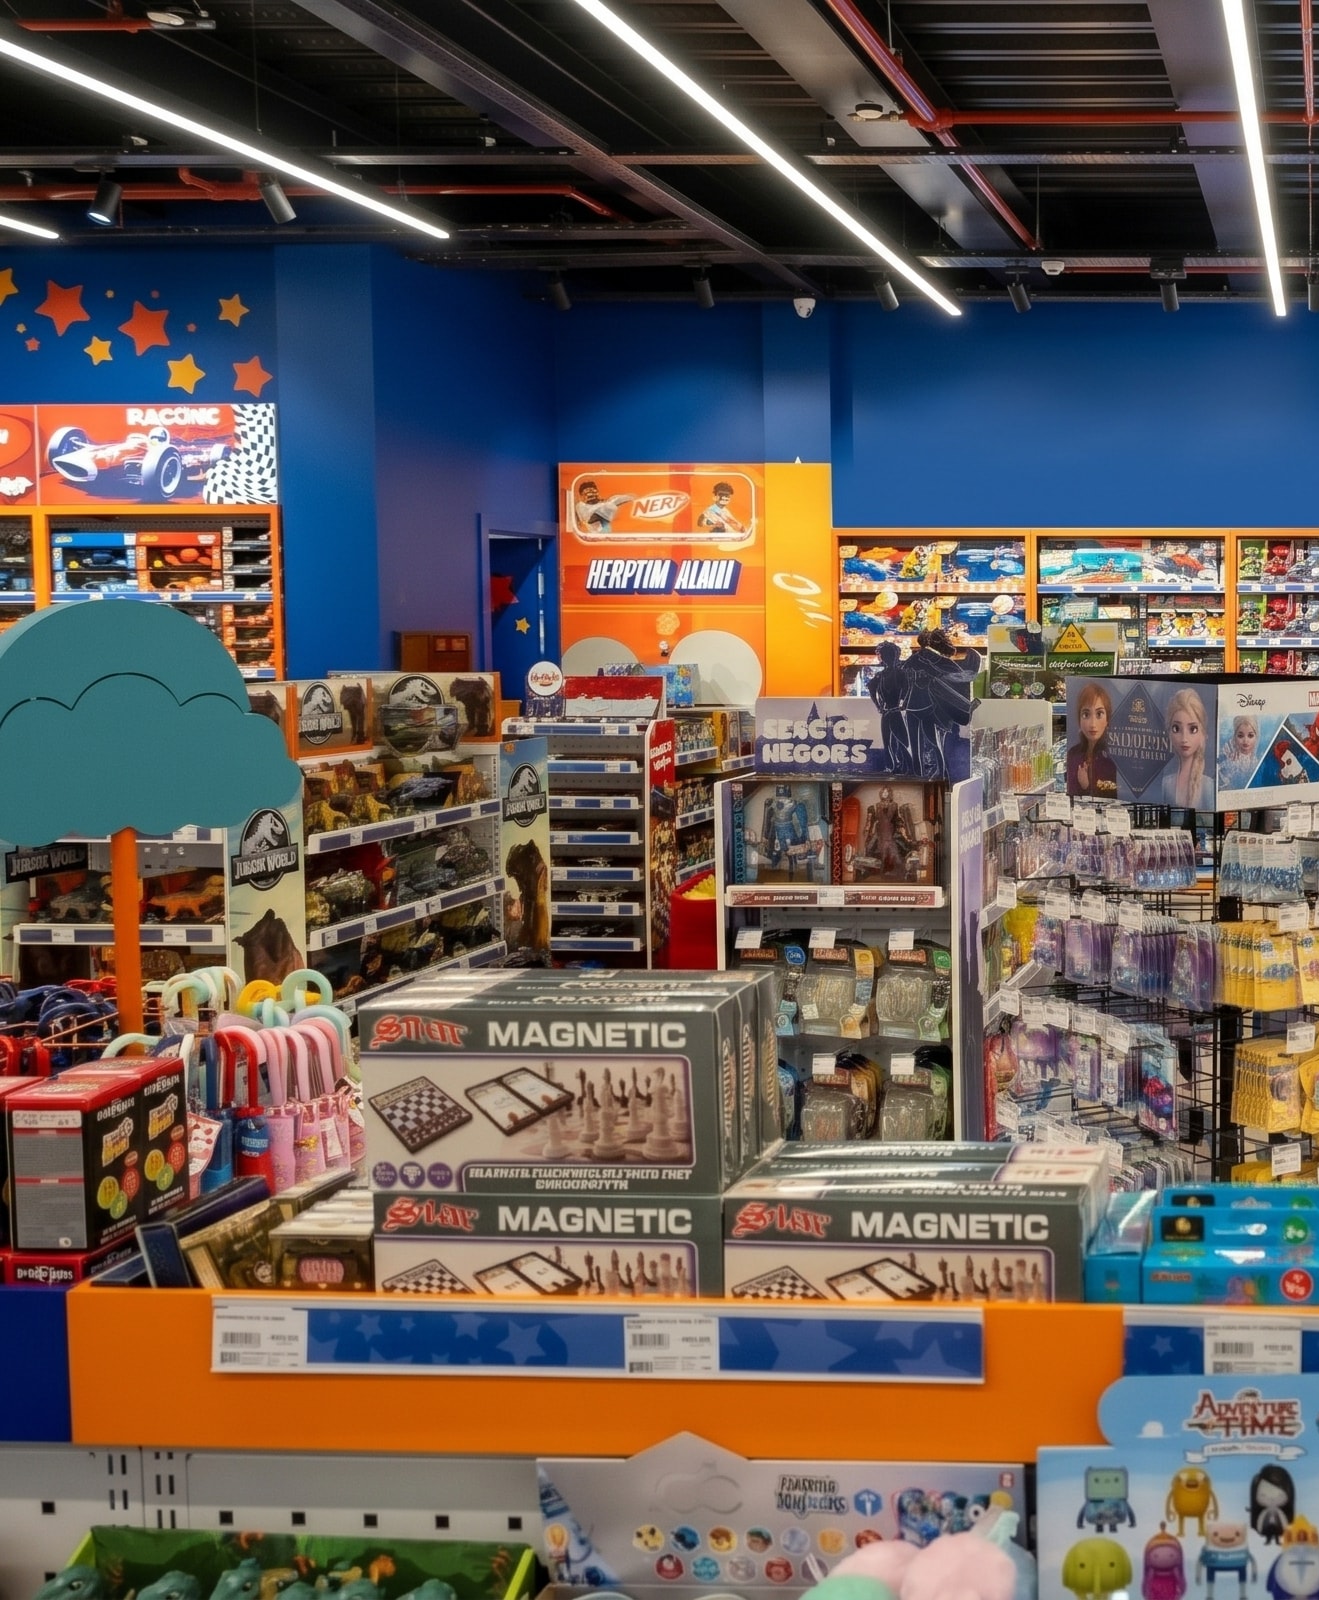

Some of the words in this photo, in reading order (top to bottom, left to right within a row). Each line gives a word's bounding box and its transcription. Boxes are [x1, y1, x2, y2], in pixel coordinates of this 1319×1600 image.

[488, 1021, 687, 1049] MAGNETIC
[499, 1206, 692, 1235] MAGNETIC
[851, 1211, 1049, 1241] MAGNETIC
[1216, 1416, 1297, 1437] TIME
